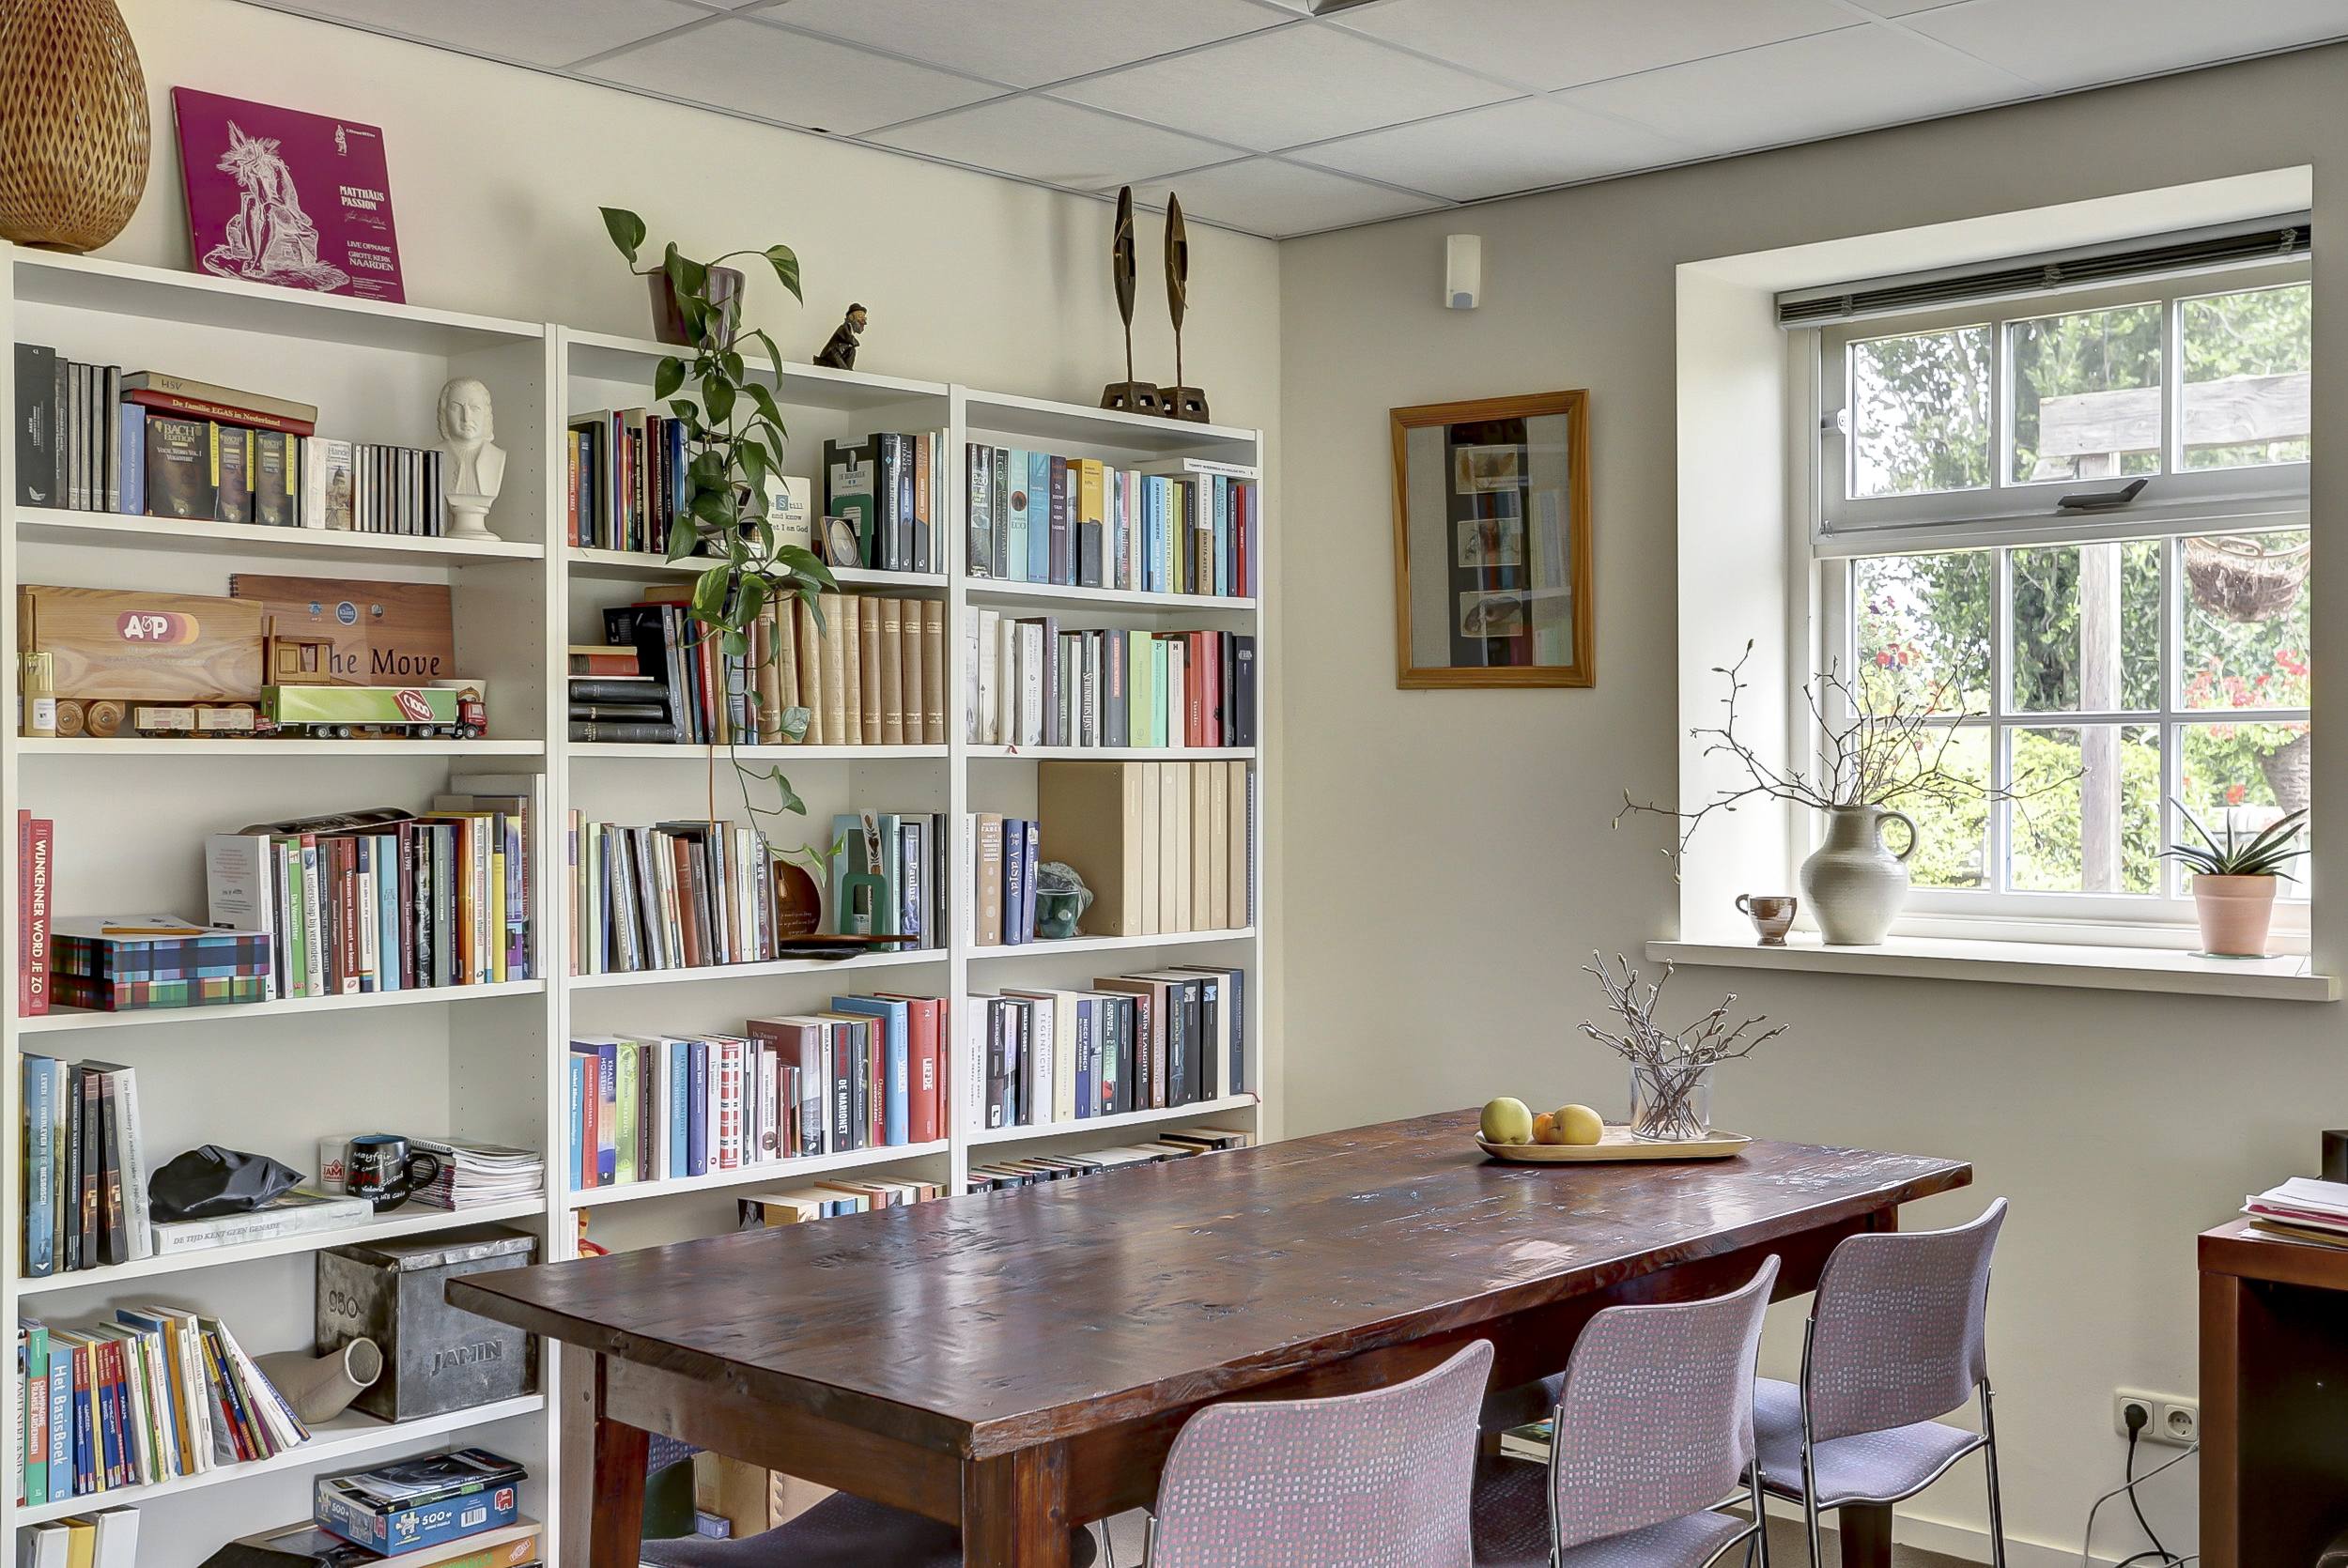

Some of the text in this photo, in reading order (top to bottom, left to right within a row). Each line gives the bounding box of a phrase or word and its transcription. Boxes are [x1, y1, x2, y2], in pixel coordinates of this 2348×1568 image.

[340, 186, 384, 201] MATTHÄUS
[341, 198, 378, 210] PASSION
[347, 240, 392, 253] LIVE OPNAME
[348, 251, 391, 262] GROTE KERK
[349, 258, 394, 271] NAARDEN
[185, 401, 210, 414] familie
[211, 407, 234, 418] EGAS
[243, 413, 281, 426] Nederland
[163, 423, 195, 436] BACH
[163, 434, 195, 443] EDITION
[1012, 521, 1027, 530] ECO
[124, 615, 168, 639] A&P
[369, 647, 441, 676] Move
[346, 869, 354, 897] Waarom
[908, 861, 919, 901] Paulus
[22, 903, 29, 915] en
[31, 839, 47, 994] WIJNKENNER WORD JE ZO
[291, 894, 300, 941] De Voorzitter
[347, 907, 355, 928] kopen
[307, 873, 320, 973] Leiderschap bij verandering
[21, 917, 29, 972] vaccineren
[923, 1009, 930, 1018] 2
[40, 1072, 49, 1095] LEVEN
[838, 1026, 847, 1135] TOMAS ROSS DE MARIONET
[897, 1060, 906, 1093] VADER
[922, 1058, 934, 1090] LIEFDE
[40, 1155, 48, 1165] DE
[353, 1151, 392, 1163] Mayfair
[40, 1166, 49, 1205] BIESBOSCH
[381, 1171, 404, 1187] Strand
[380, 1192, 391, 1201] Hill
[173, 1222, 281, 1245] DE TIJD KENT GEEN GENADE
[429, 1338, 502, 1378] JAMIN
[223, 1370, 239, 1410] BARCELONA
[53, 1364, 69, 1467] Het BasisBoek
[30, 1412, 39, 1455] ARDENNEN
[332, 1503, 346, 1516] 500
[422, 1511, 446, 1527] 500
